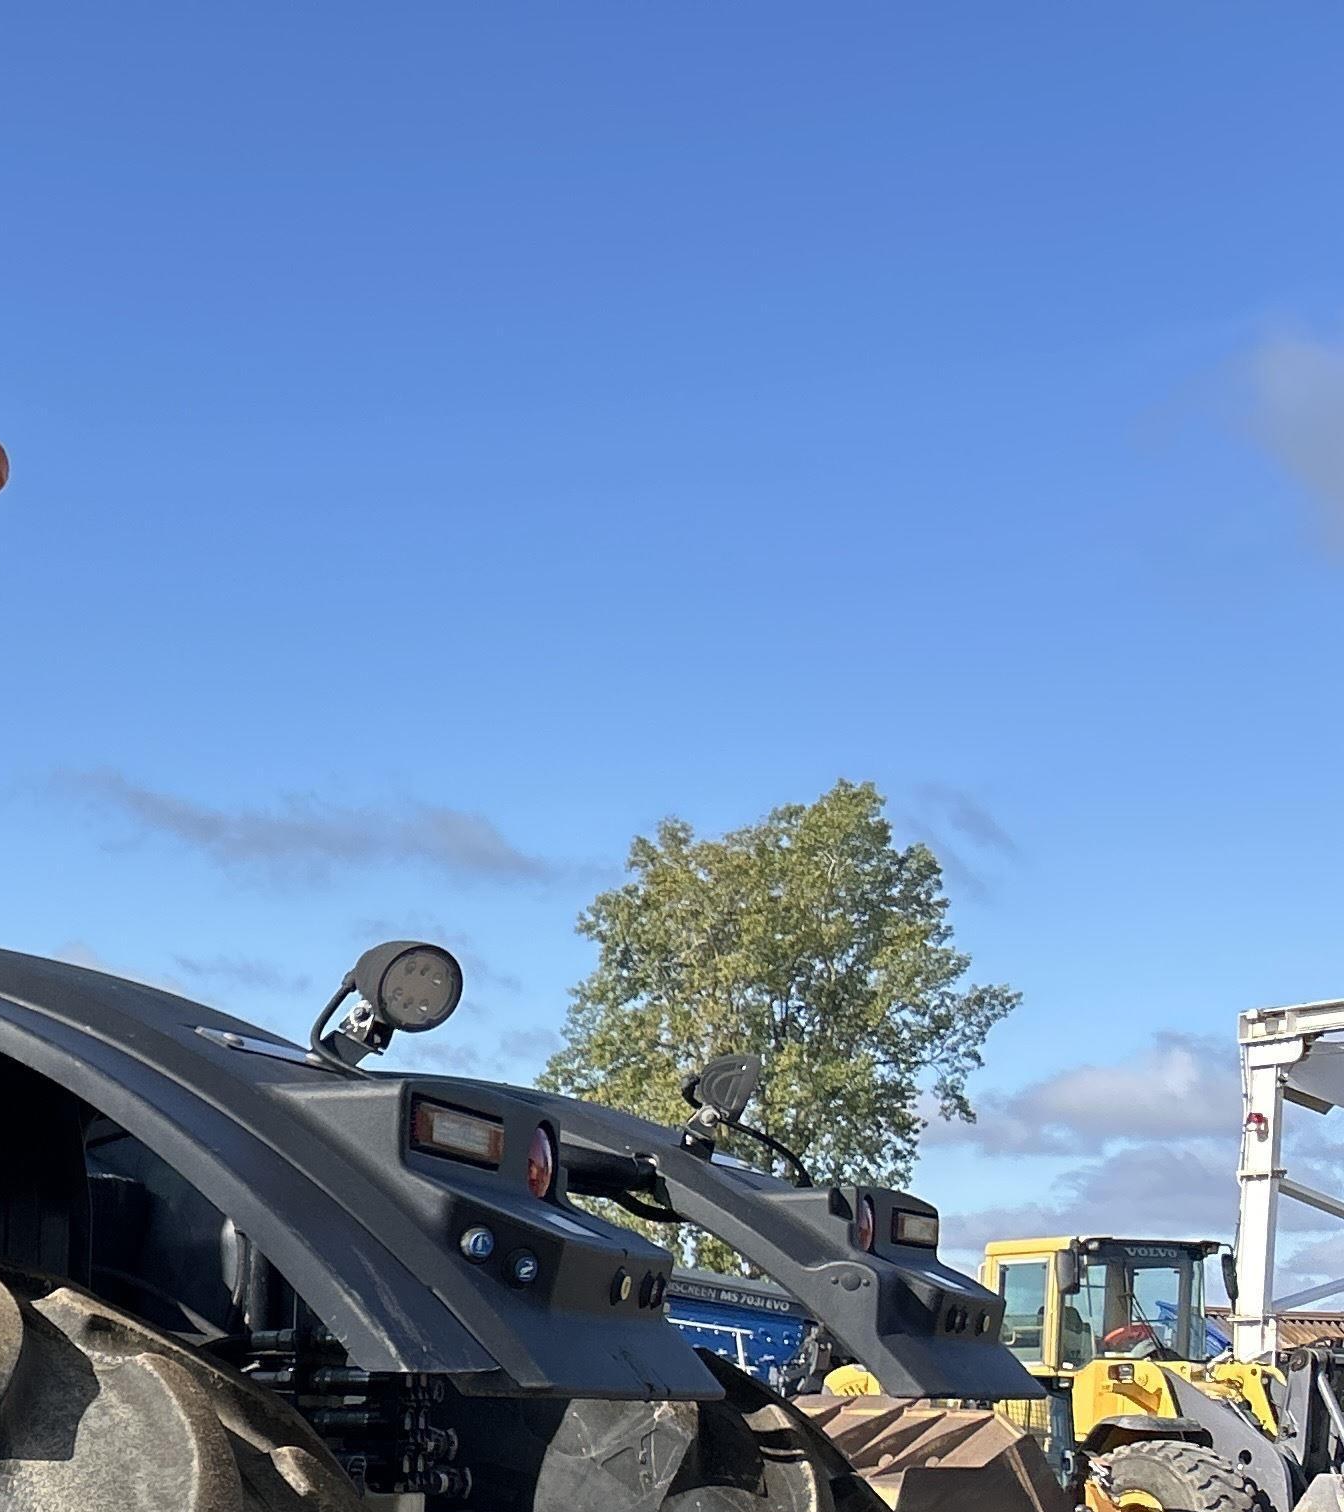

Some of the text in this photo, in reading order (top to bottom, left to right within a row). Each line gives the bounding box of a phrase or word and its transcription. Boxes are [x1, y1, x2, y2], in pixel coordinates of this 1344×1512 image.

[1125, 1247, 1178, 1258] VOLVO
[719, 1290, 739, 1303] MS
[766, 1299, 791, 1312] EVO
